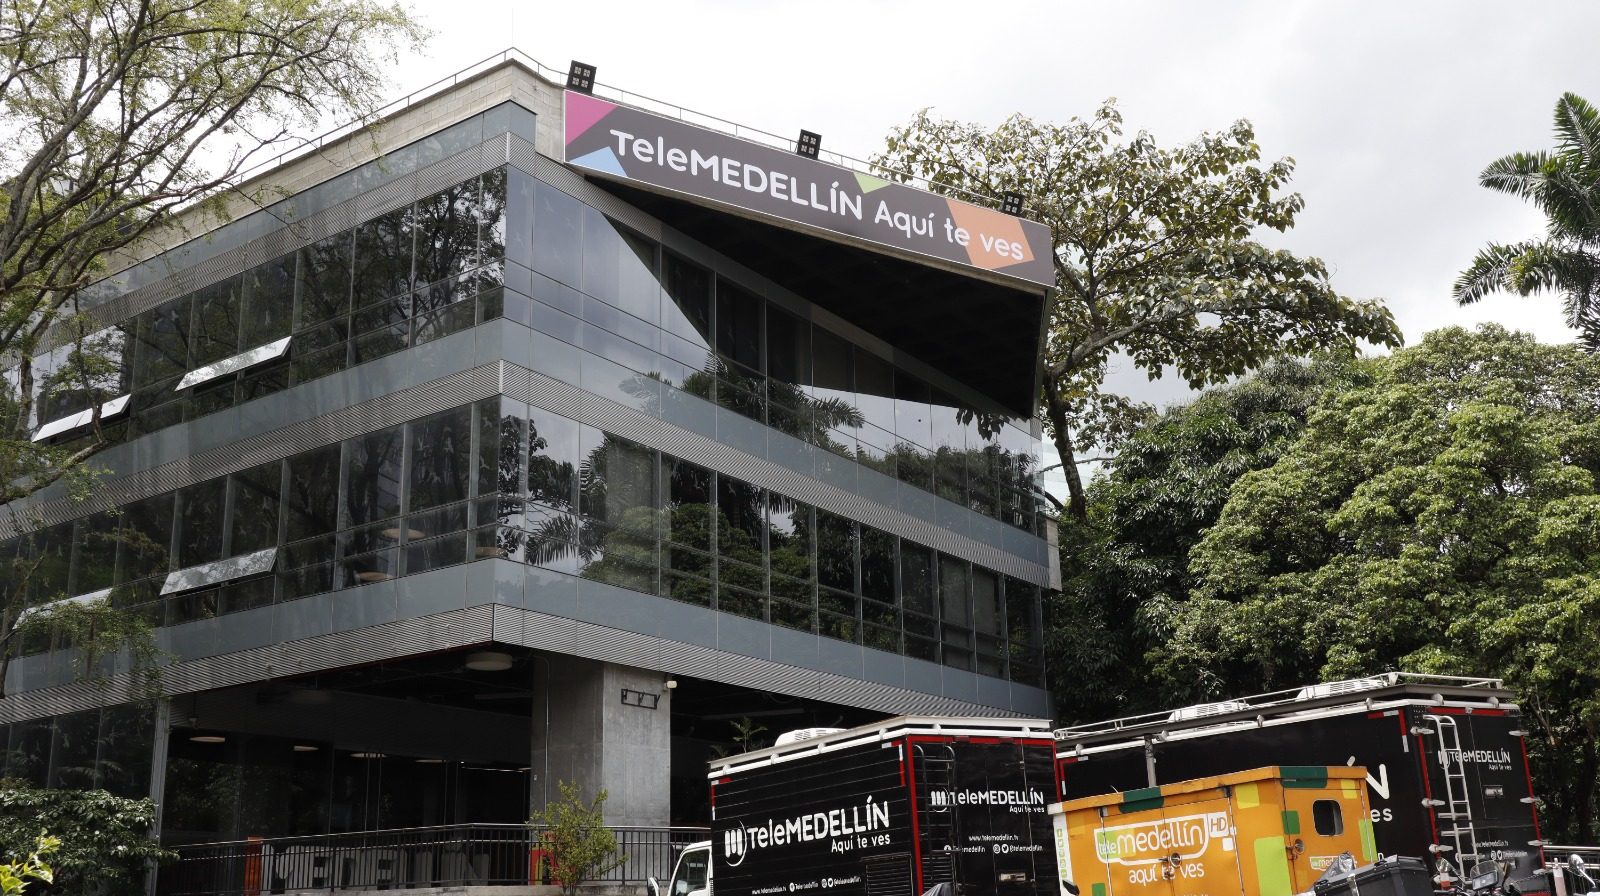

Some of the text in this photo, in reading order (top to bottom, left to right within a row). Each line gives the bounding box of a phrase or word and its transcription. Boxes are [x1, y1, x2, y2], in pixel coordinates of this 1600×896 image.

[610, 129, 1024, 261] TeleMEDELLÍN Aquí te ves
[1450, 747, 1511, 763] TeeMEDELLÍN
[949, 787, 1044, 805] TeleMEDELLÍN
[747, 795, 889, 849] TeleMEDELLÍN
[1370, 808, 1393, 822] es
[1210, 816, 1227, 833] HD
[857, 834, 868, 848] te
[871, 834, 890, 846] ves
[1129, 864, 1158, 886] aquí
[1181, 863, 1205, 879] ves
